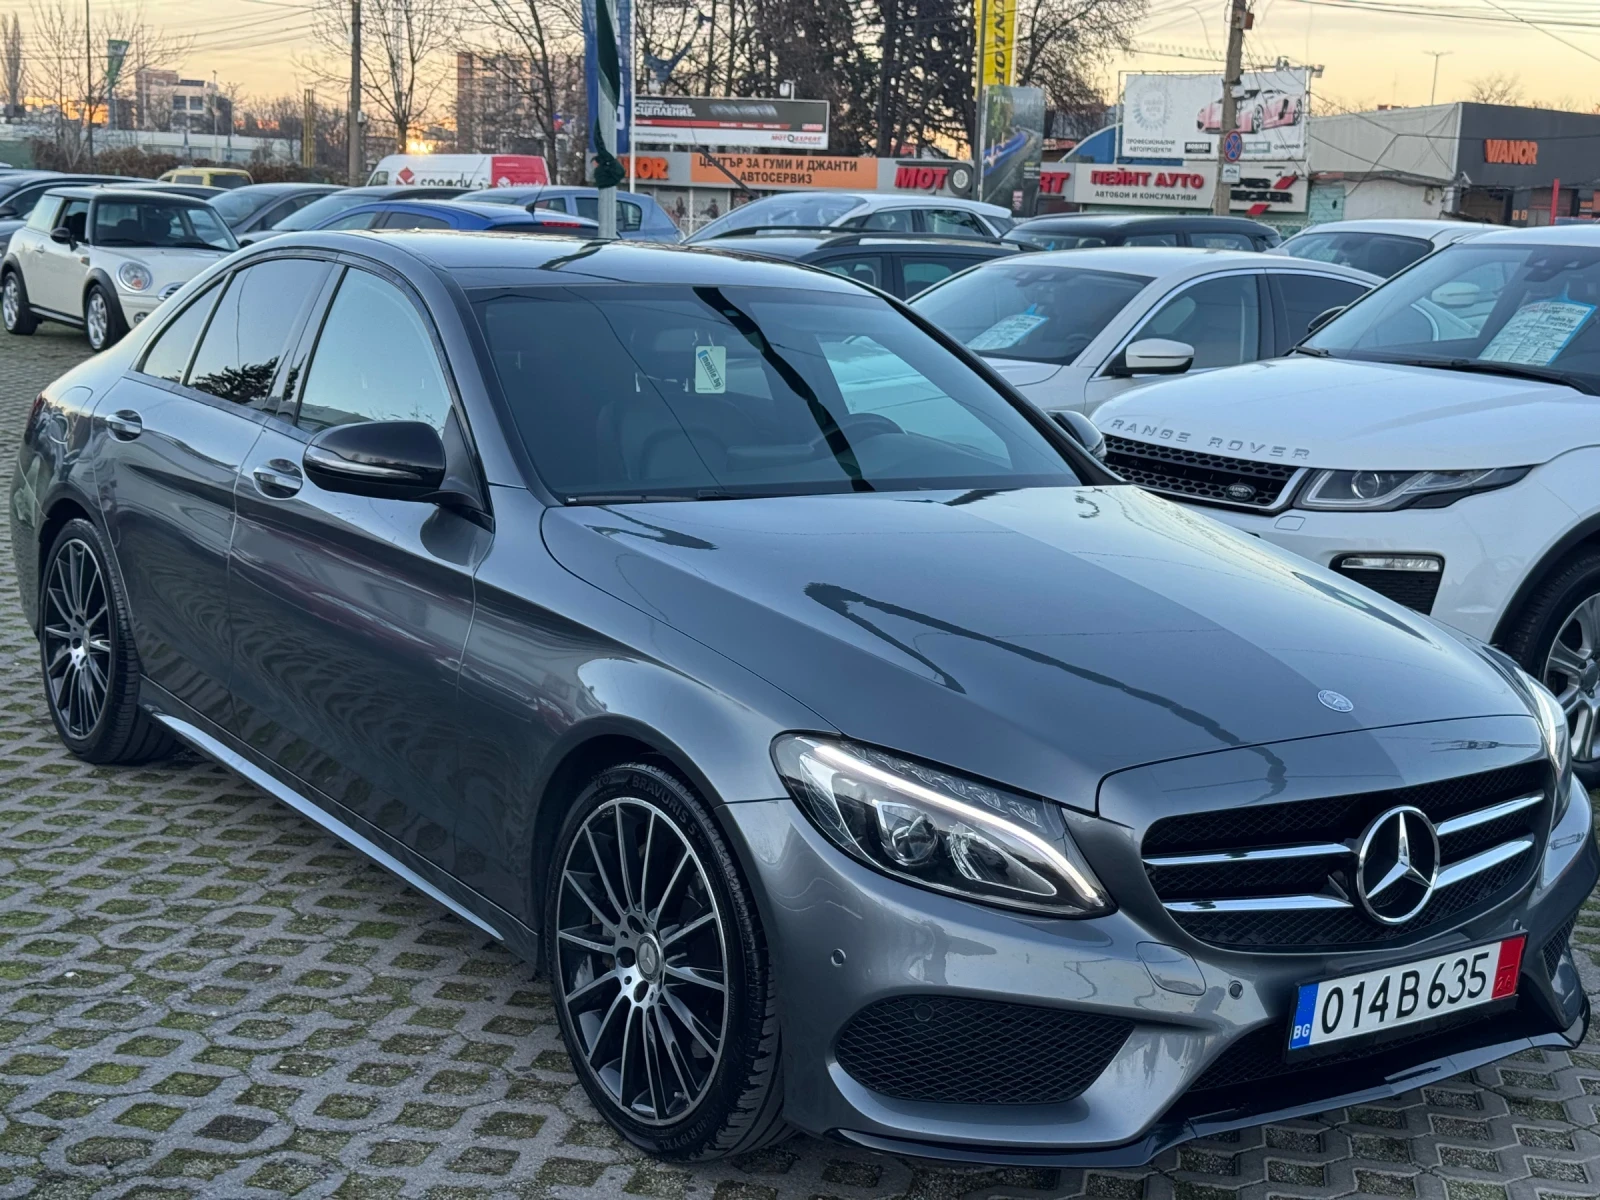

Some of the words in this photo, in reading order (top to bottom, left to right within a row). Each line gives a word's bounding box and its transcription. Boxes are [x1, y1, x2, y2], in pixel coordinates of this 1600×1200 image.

[993, 0, 1006, 86] UNLOP
[746, 158, 760, 168] ЗА
[763, 158, 793, 170] ГУМИ
[796, 159, 804, 170] И
[806, 159, 858, 173] ДЖАНТИ
[740, 171, 813, 185] АВТОСЕРВИЗ
[1091, 167, 1151, 187] ПЕЙНТ
[1154, 172, 1205, 189] АУТО
[1094, 190, 1131, 199] АВТОБОИ
[1139, 192, 1198, 201] КОНСУМАТИВИ
[1110, 418, 1192, 443] RANGE
[1206, 436, 1312, 460] ROVER
[632, 774, 690, 824] BRAVURIS
[1320, 951, 1490, 1035] 014B635
[1293, 1023, 1311, 1040] BG
